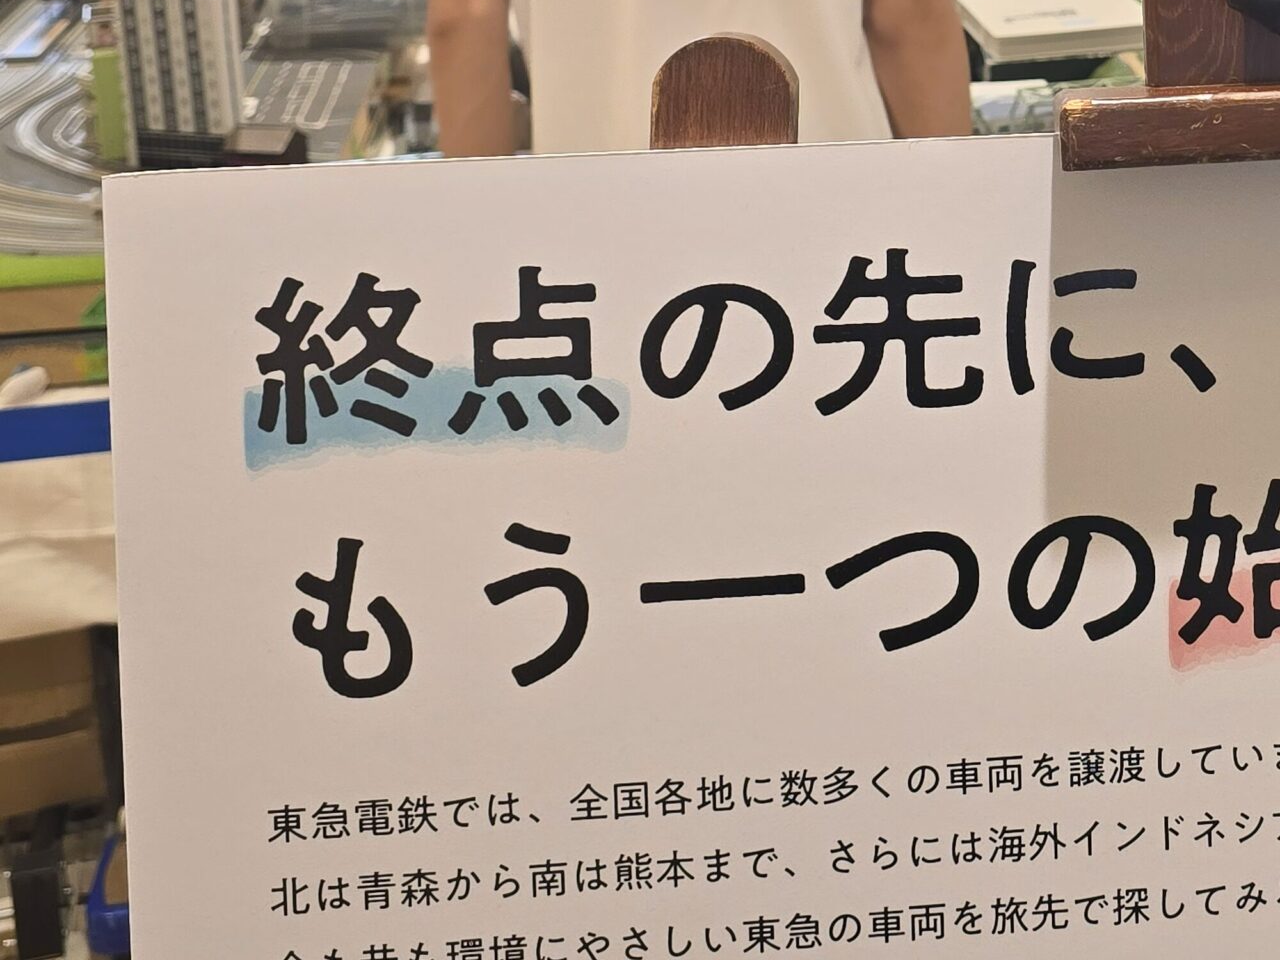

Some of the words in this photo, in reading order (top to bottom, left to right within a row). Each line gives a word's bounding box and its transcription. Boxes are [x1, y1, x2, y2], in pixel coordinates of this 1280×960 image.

[254, 247, 1216, 446] 終点の先に、
